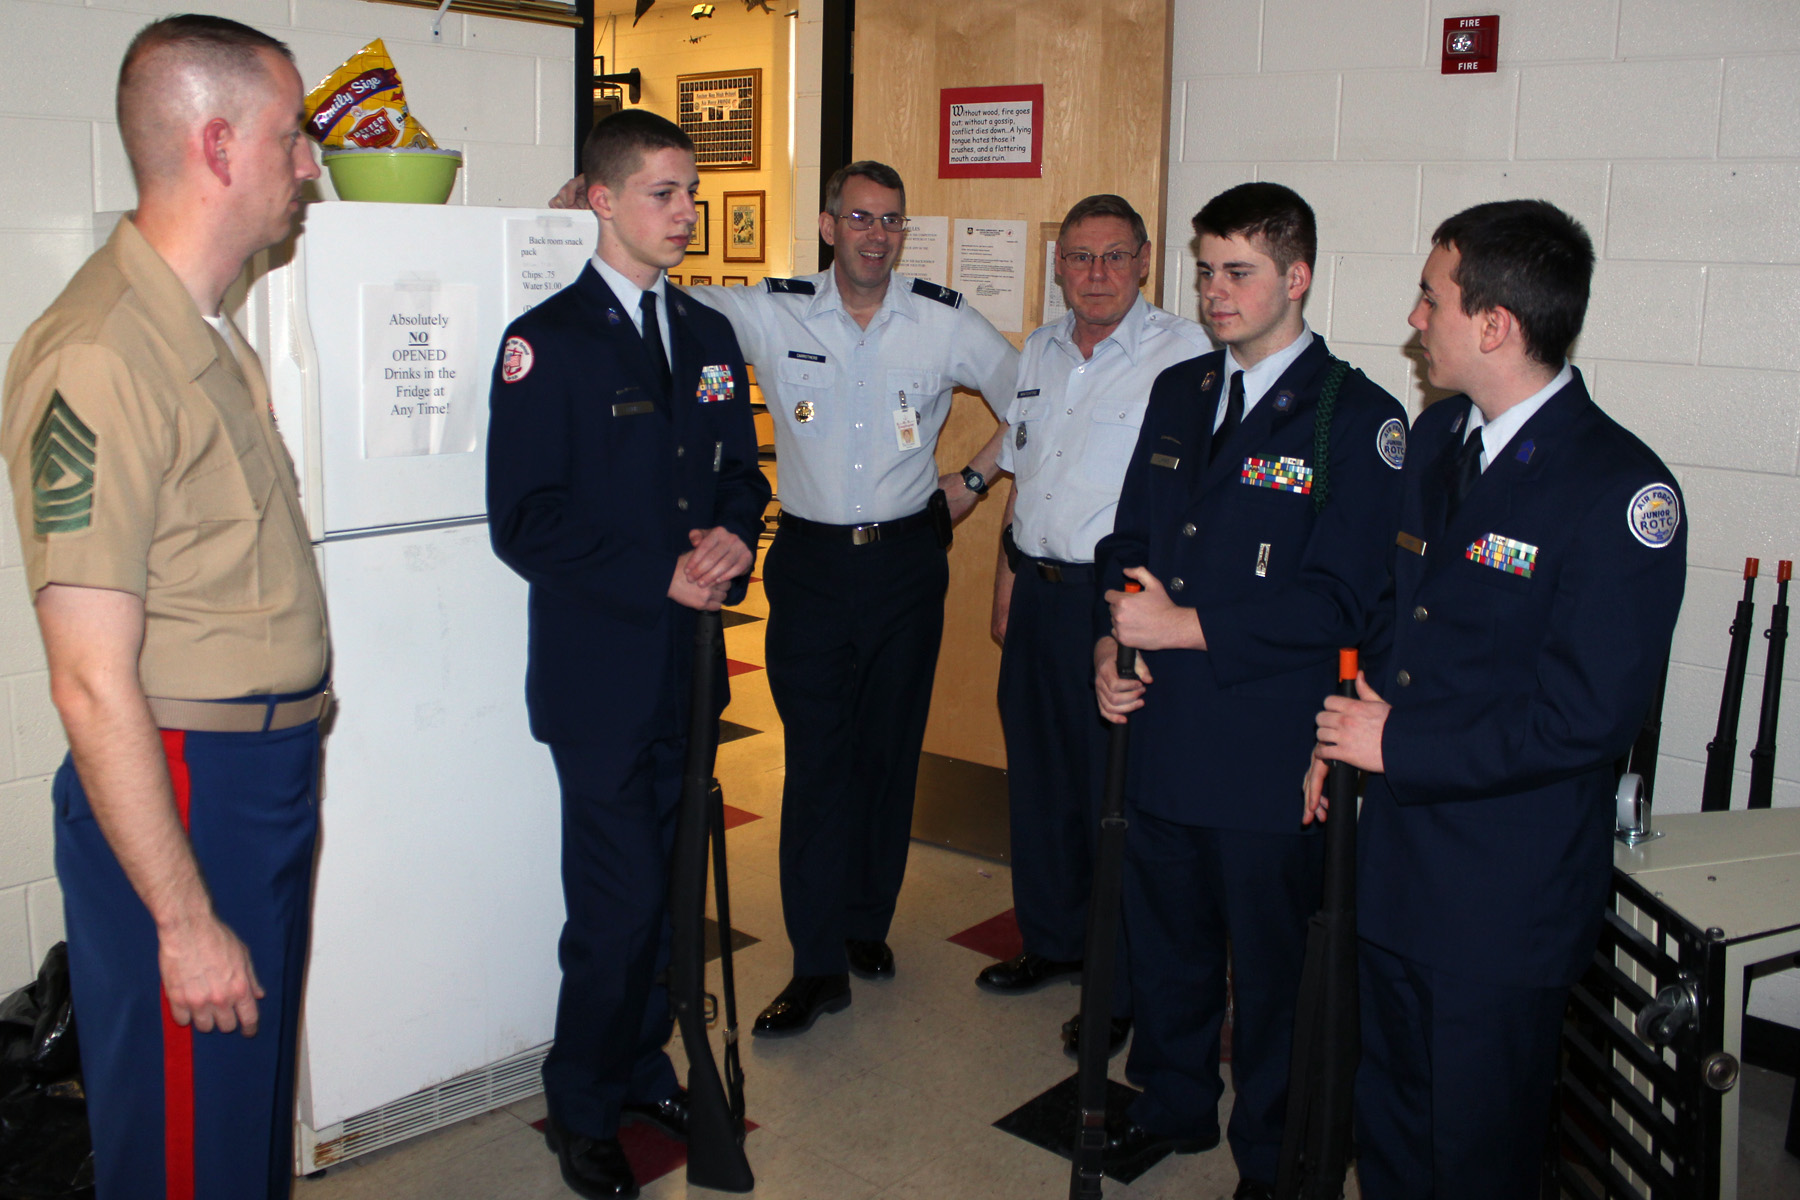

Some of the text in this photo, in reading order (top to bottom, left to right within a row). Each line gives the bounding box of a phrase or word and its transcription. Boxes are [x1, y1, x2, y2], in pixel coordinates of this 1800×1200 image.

[1460, 18, 1480, 28] FIRE
[1458, 62, 1478, 70] FIRE
[313, 77, 381, 130] Family Size
[952, 105, 981, 116] Without
[982, 108, 1000, 116] wood,
[1016, 108, 1030, 116] goes
[353, 116, 386, 138] BETTER
[361, 125, 386, 140] MADE
[1016, 126, 1032, 134] lying
[995, 145, 1026, 154] flattering
[528, 236, 546, 245] Back
[521, 248, 537, 257] pack
[522, 270, 544, 280] Chips:
[522, 282, 562, 290] Water $1.00
[389, 314, 449, 328] Absolutely
[408, 331, 429, 344] NO
[392, 350, 446, 361] OPENED
[384, 367, 456, 380] Drinks in the
[396, 385, 444, 400] Fridge at
[390, 403, 450, 418] Any Time!
[1637, 492, 1673, 510] AIR FORCE
[1642, 509, 1670, 520] JUNIOR
[1640, 517, 1673, 531] ROTC
